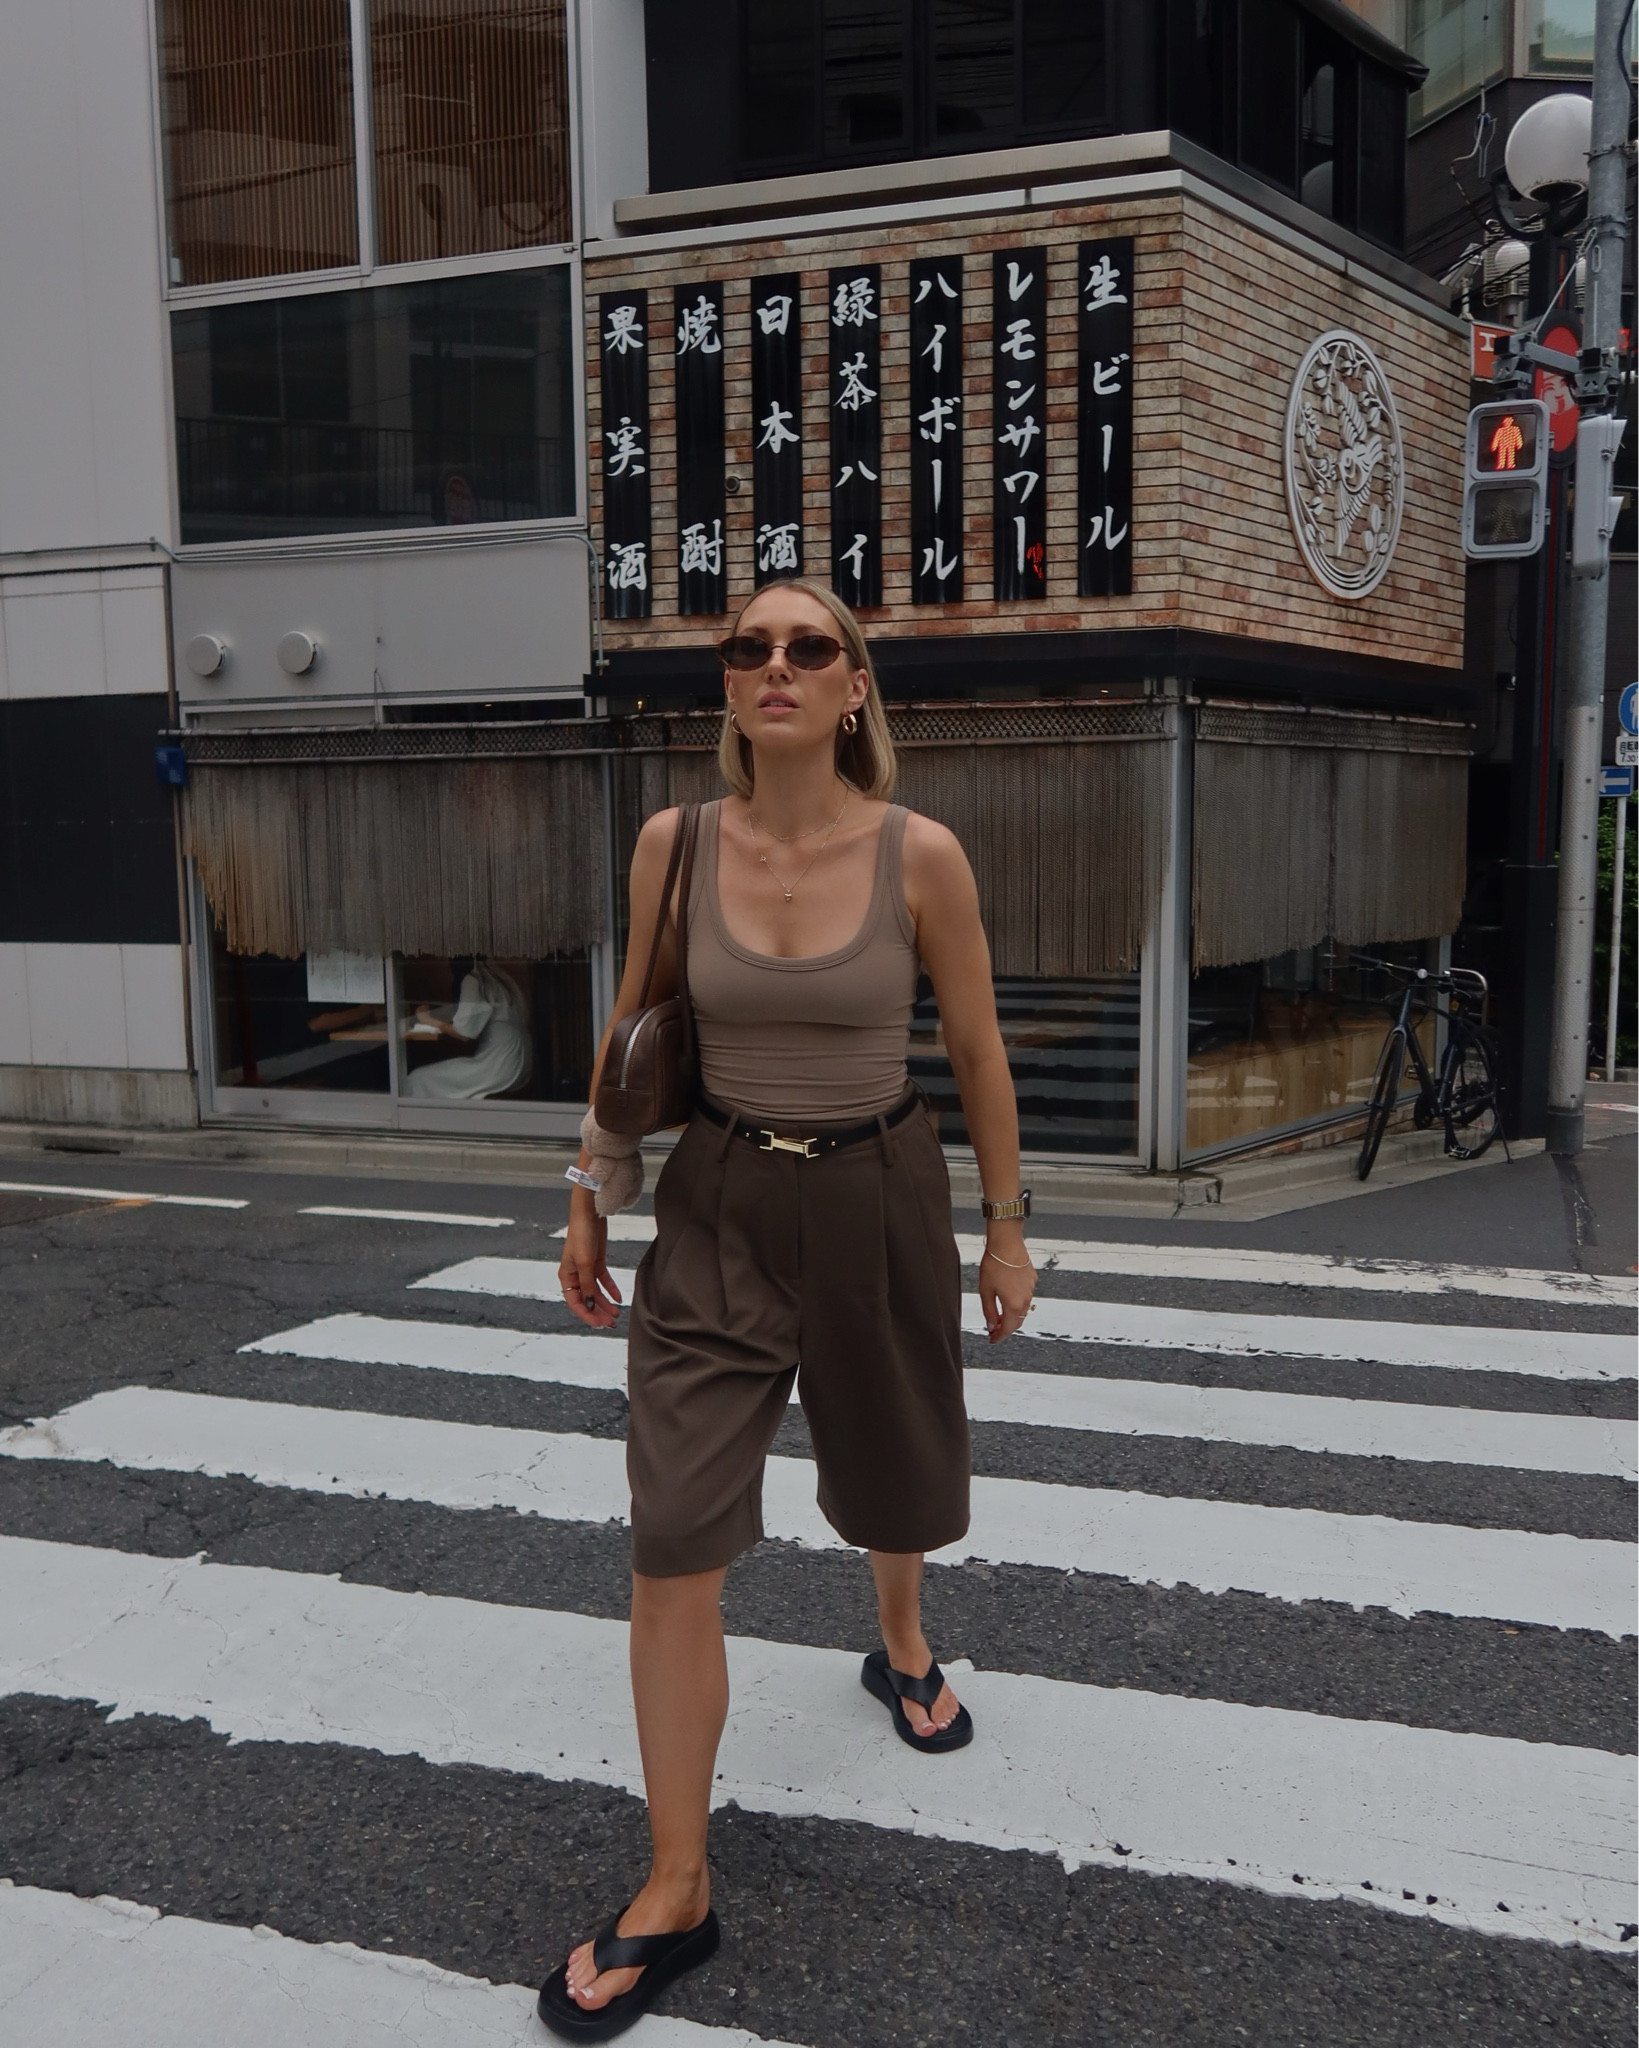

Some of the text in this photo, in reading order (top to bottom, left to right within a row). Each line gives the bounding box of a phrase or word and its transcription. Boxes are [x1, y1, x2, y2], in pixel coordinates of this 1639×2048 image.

[604, 305, 647, 591] 果実酒
[677, 296, 723, 576] 焼酎
[756, 296, 800, 572] 日本酒
[832, 278, 878, 580] 緑茶ハイ
[914, 272, 960, 580] ハイボール
[999, 262, 1040, 574] レモンサワー
[1085, 256, 1129, 550] 生ビール
